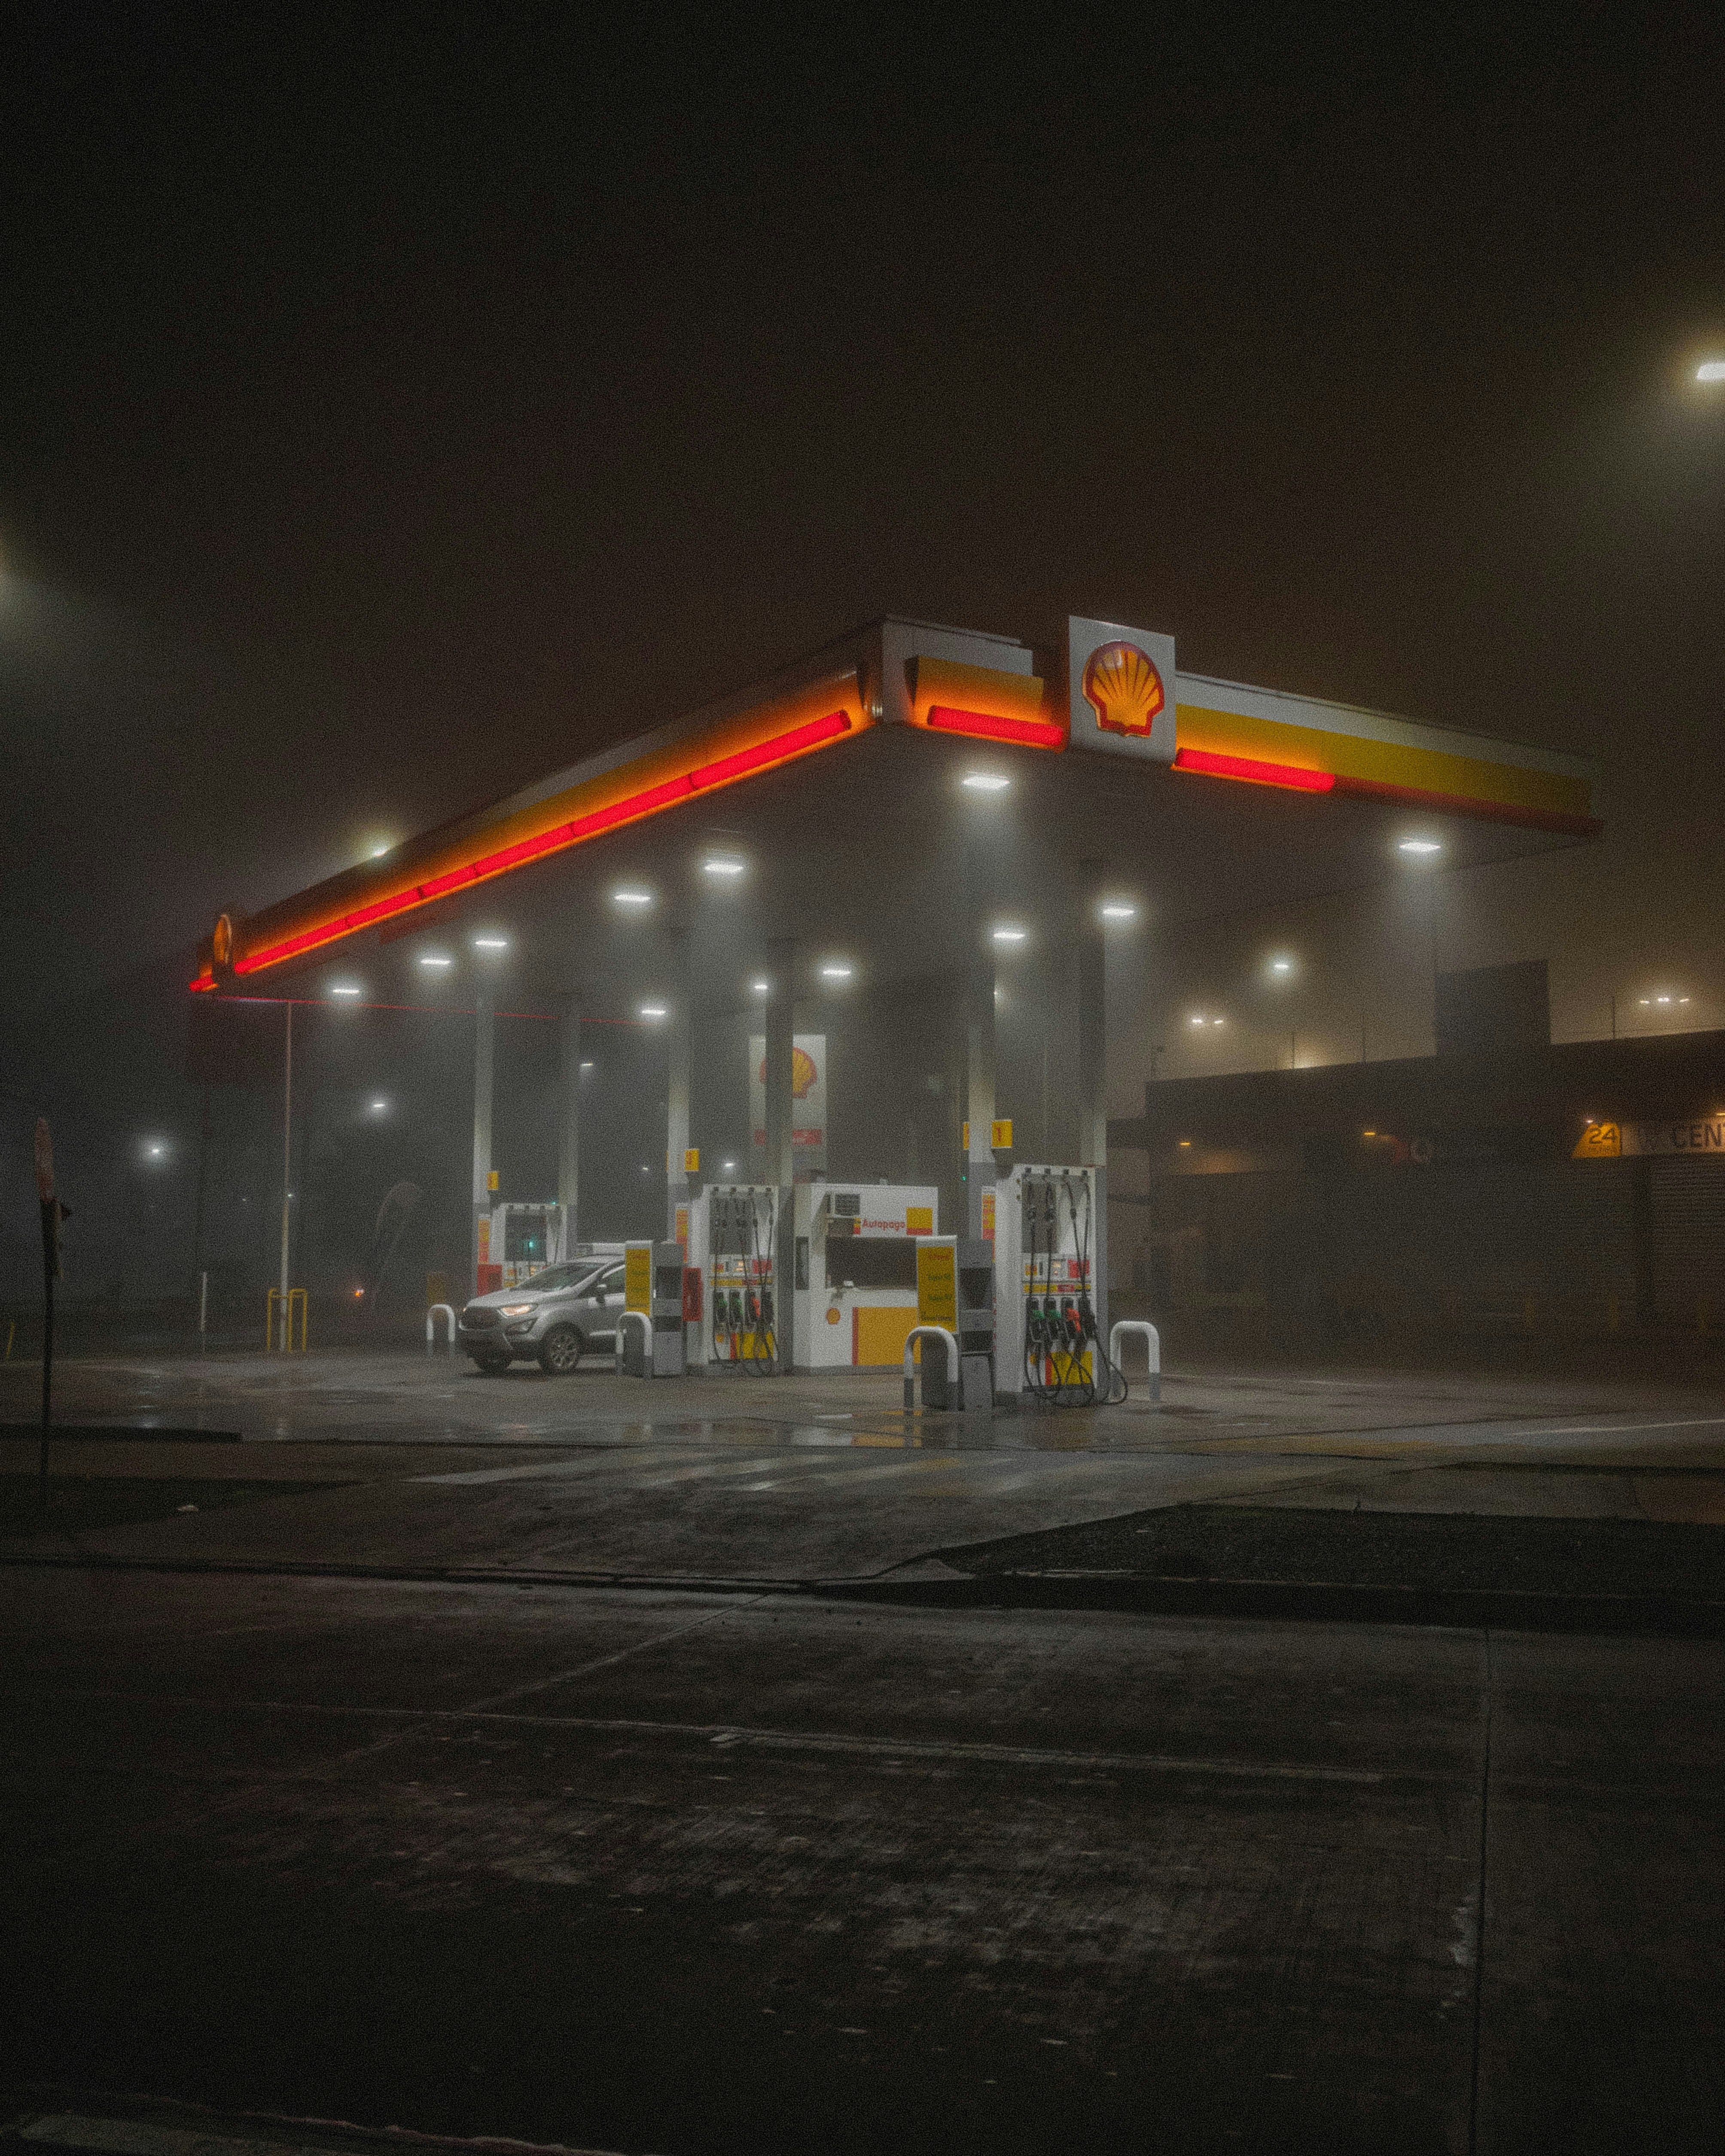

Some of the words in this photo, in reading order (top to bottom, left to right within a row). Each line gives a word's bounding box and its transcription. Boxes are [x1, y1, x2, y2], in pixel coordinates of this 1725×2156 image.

[1589, 1127, 1617, 1145] 24
[1672, 1124, 1725, 1148] CEN
[862, 1218, 905, 1231] Autopago
